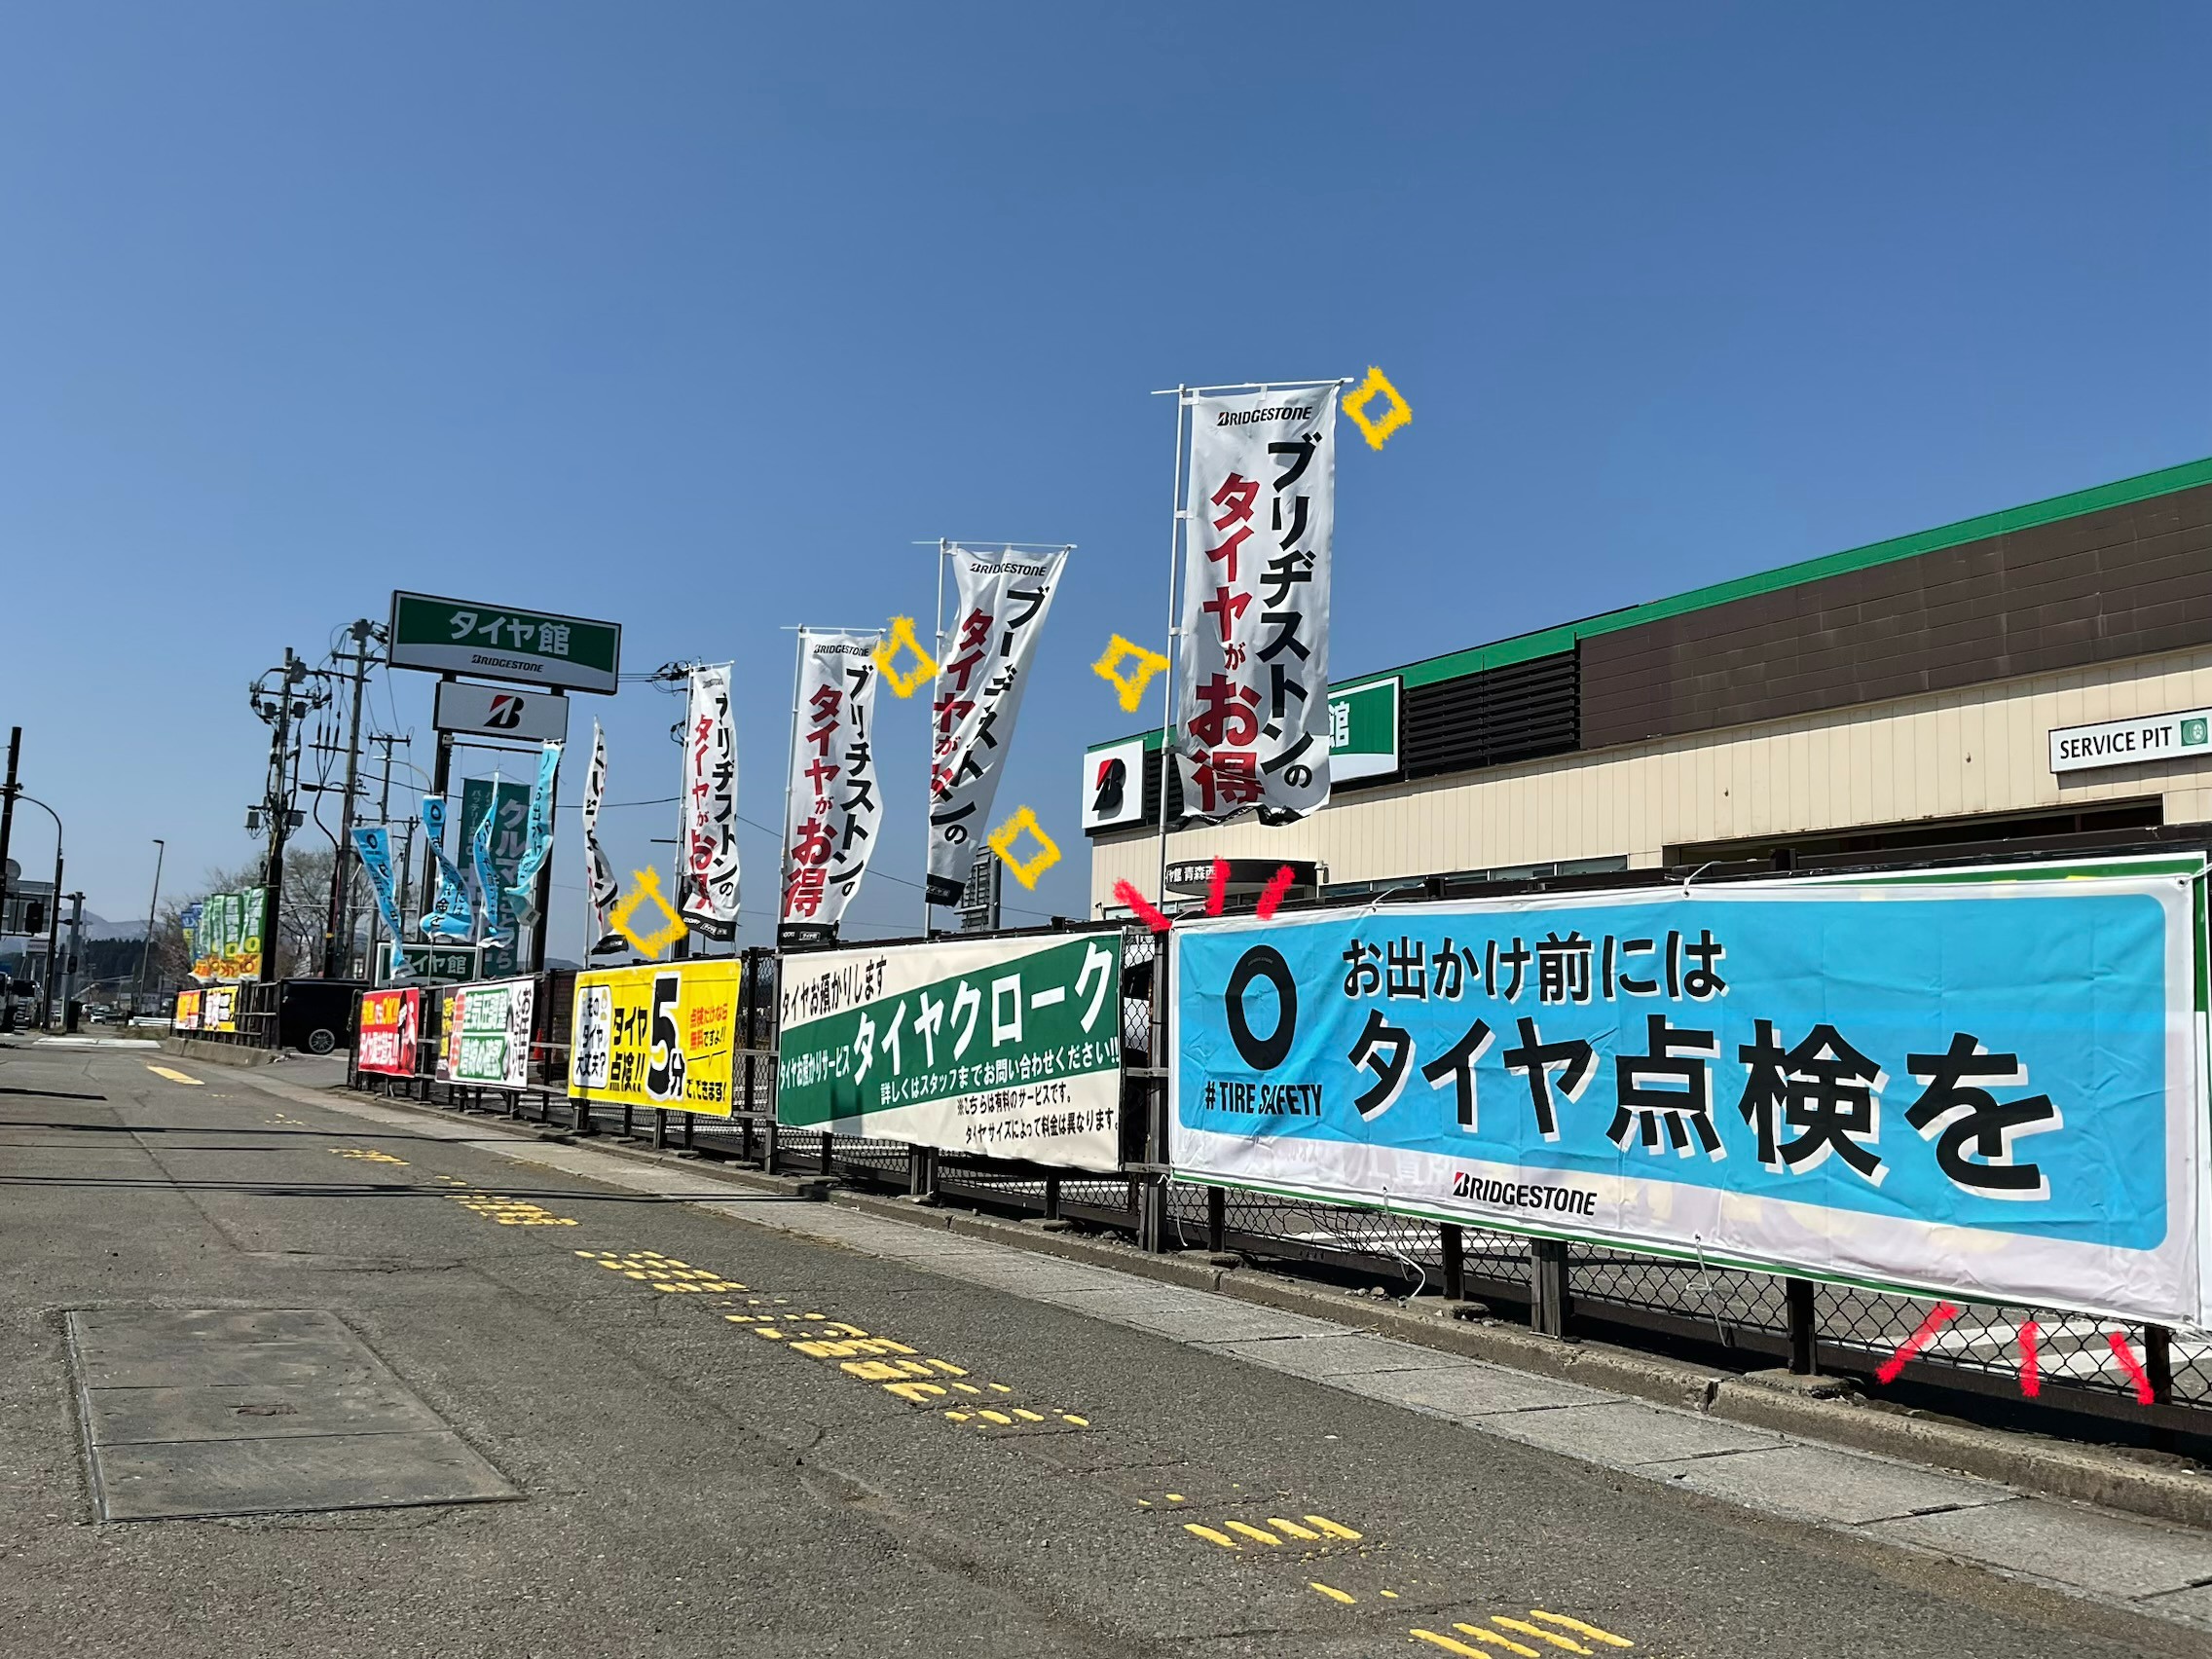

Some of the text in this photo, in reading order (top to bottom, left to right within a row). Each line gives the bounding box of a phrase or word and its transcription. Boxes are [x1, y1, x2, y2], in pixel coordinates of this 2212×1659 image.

[1216, 406, 1312, 426] BRIDGESTONE
[970, 563, 1047, 576] BRIDESTONE
[1256, 431, 1322, 790] ブリヂストンの
[449, 611, 571, 656] タイヤ館
[1188, 472, 1266, 812] タイヤがお得
[471, 654, 544, 673] BRIDGESTONE
[2060, 726, 2172, 759] SERVICE PIT
[784, 683, 843, 917] タイヤがお得
[1342, 928, 1726, 1004] お出かけ前には
[782, 955, 887, 1025] タイヤお預かりします
[614, 1006, 647, 1047] タイヤ
[853, 941, 1113, 1086] タイヤクローク
[780, 1045, 850, 1090] タイヤお預かりサービス
[1258, 1082, 1322, 1117] SAFETY
[1346, 1008, 2061, 1198] タイヤ点検を
[1453, 1171, 1598, 1217] BRIDGESTONE
